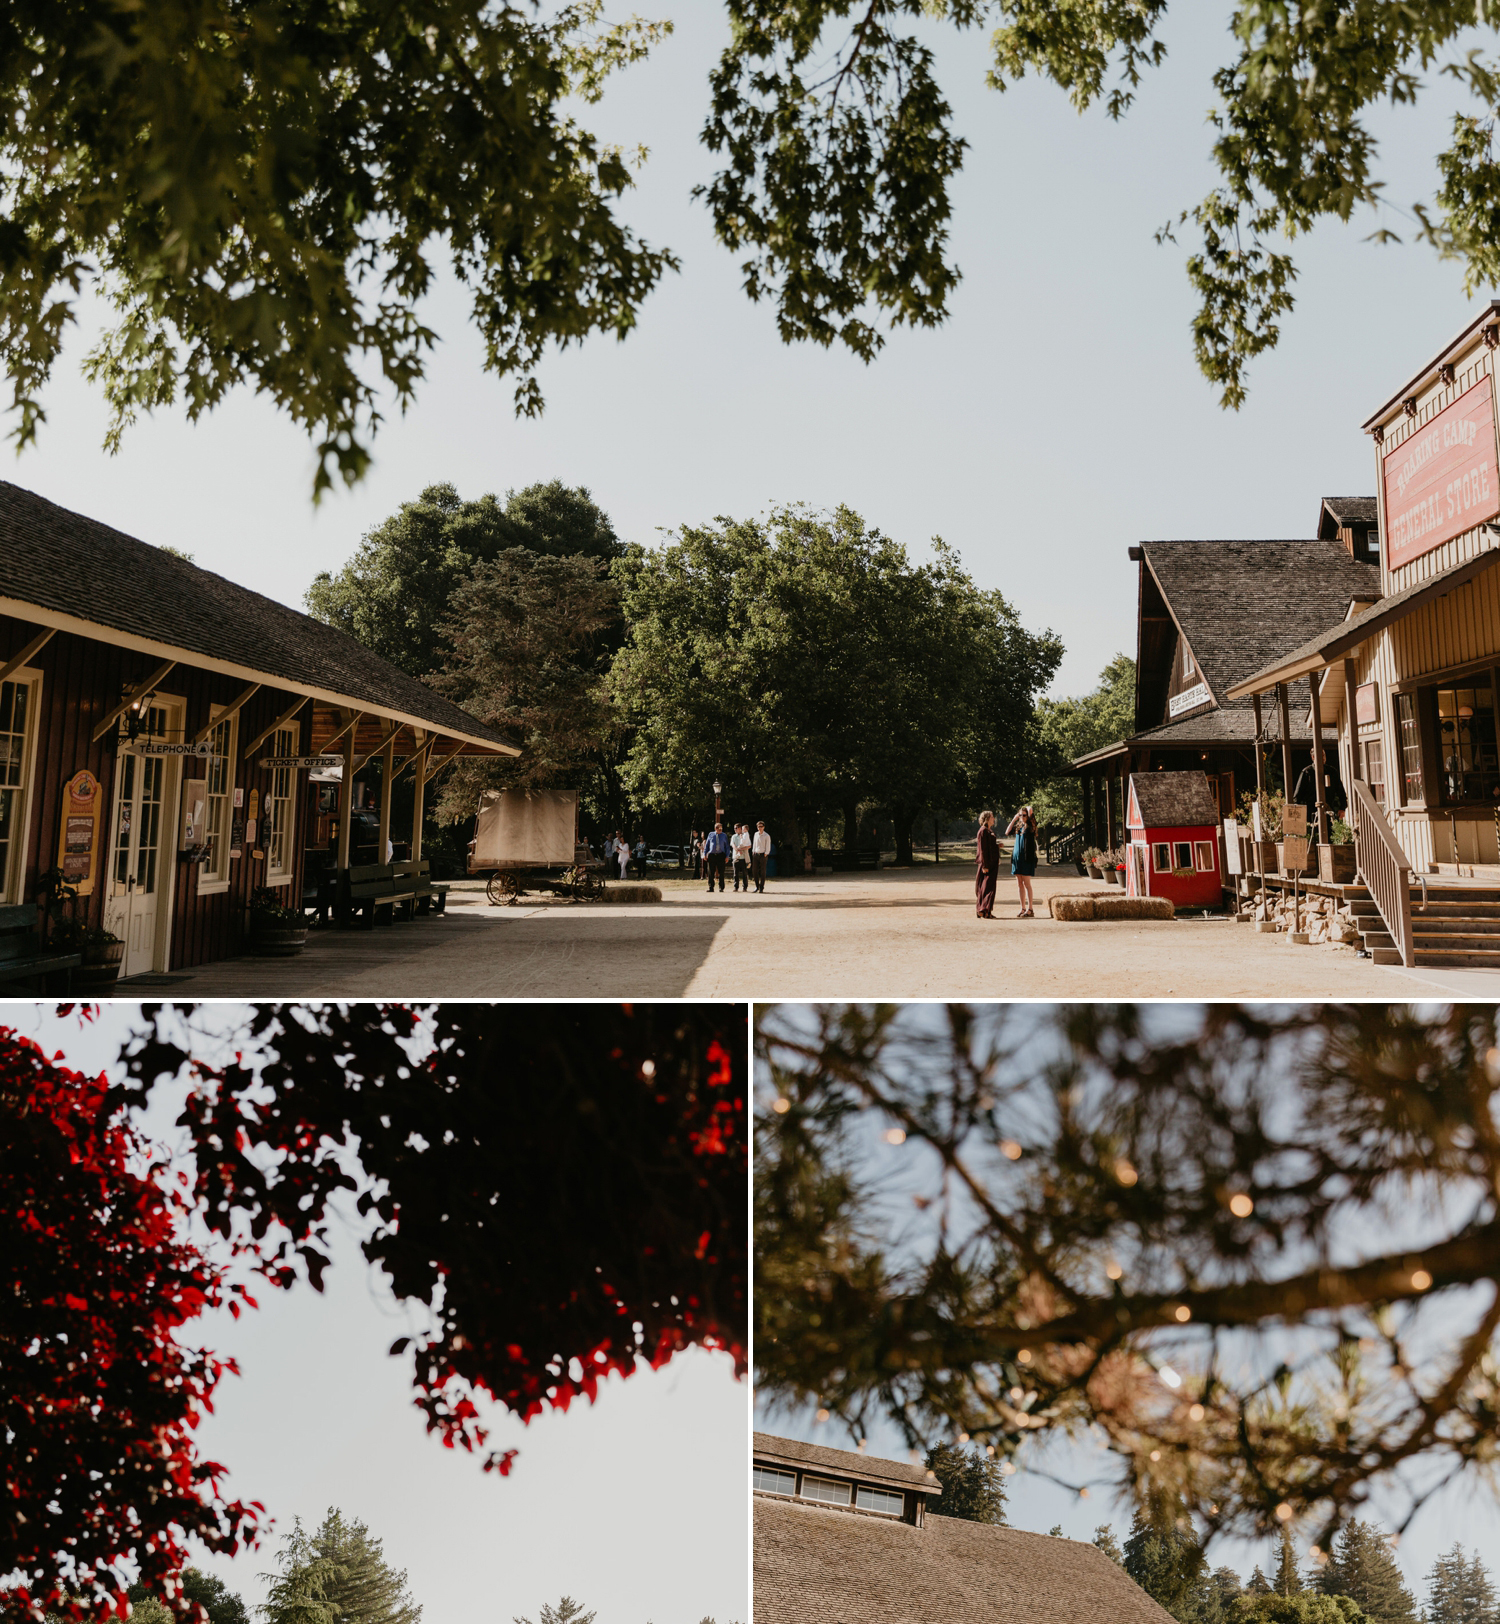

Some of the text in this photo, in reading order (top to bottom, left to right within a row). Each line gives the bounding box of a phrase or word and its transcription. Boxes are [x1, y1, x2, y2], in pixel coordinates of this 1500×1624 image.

[1397, 428, 1440, 497] ROARING
[1443, 419, 1477, 448] CAMP
[1393, 491, 1444, 551] GENERAL
[1446, 461, 1490, 519] STORE
[140, 744, 196, 754] TELEPHONE
[266, 758, 337, 767] TICKET OFFICE
